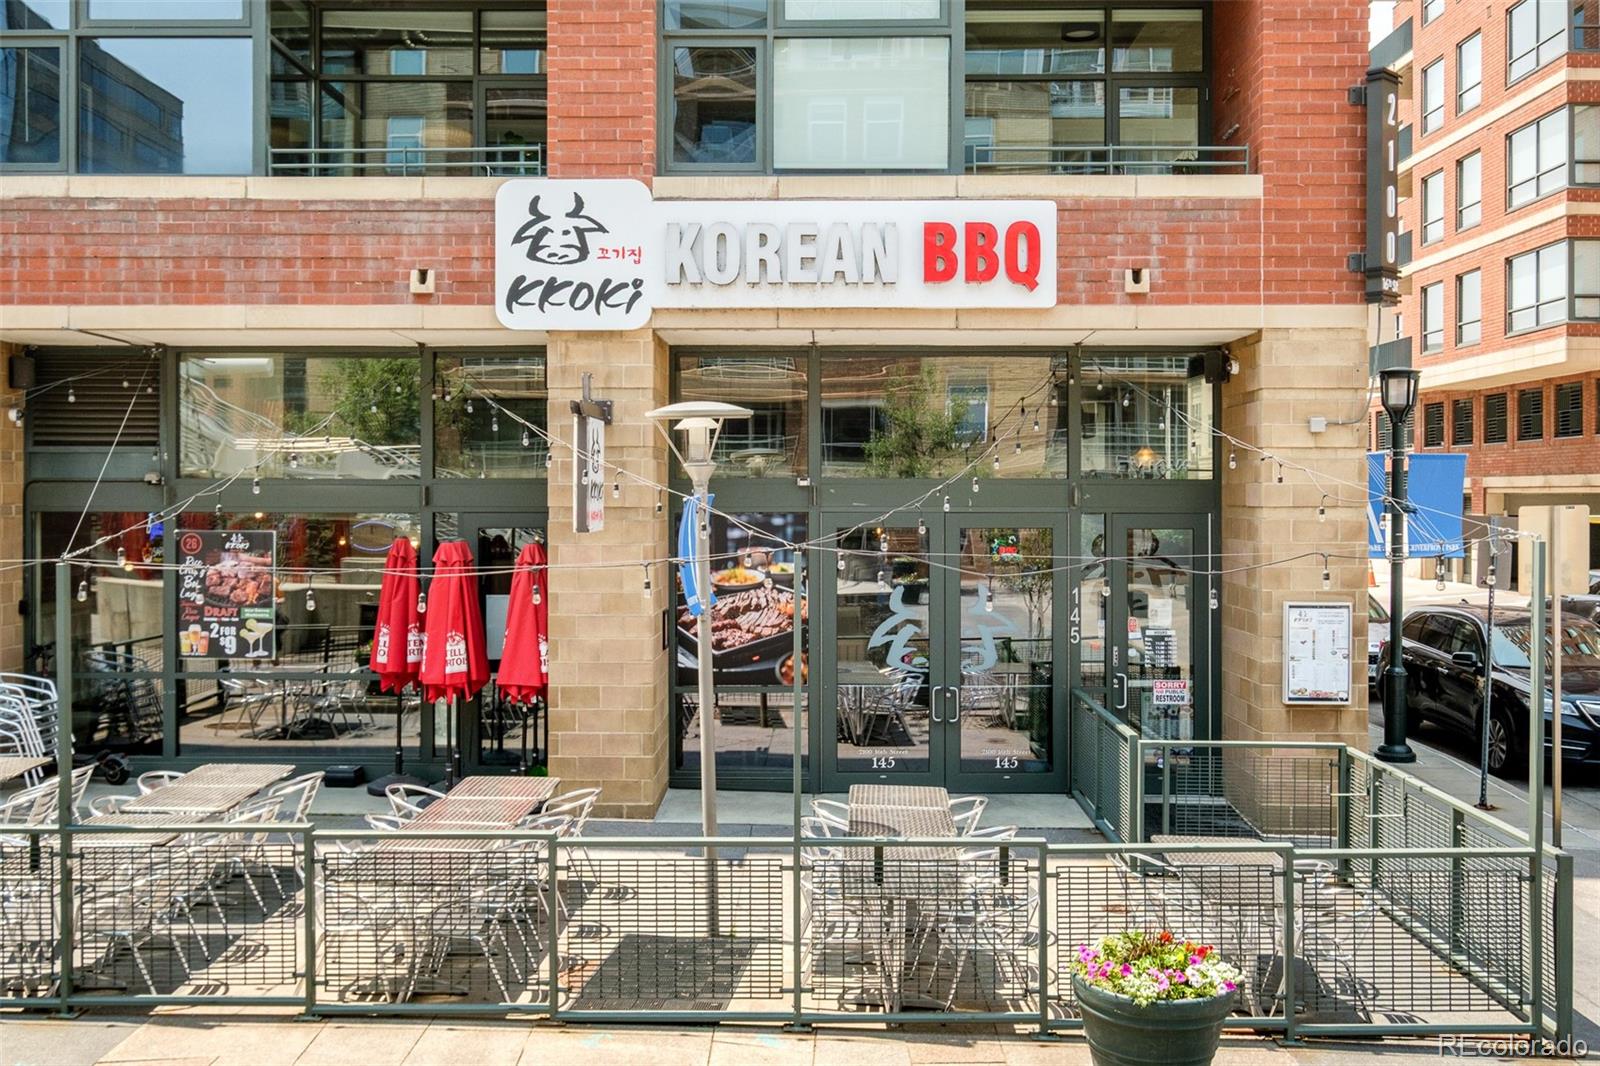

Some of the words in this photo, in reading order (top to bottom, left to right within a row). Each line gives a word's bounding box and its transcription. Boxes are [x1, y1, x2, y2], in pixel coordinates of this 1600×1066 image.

[1386, 92, 1396, 264] 2100
[597, 245, 642, 264] 꼬기집
[666, 221, 896, 285] KOREAN
[923, 220, 1042, 292] BBQ
[204, 606, 239, 617] DRAFT
[1070, 588, 1081, 644] 145
[210, 623, 219, 638] 2
[220, 626, 236, 636] FOR
[219, 636, 237, 655] $9
[1155, 681, 1185, 689] SORRY
[1155, 695, 1185, 703] RESTROOM
[871, 756, 895, 769] 145
[995, 756, 1018, 769] 145
